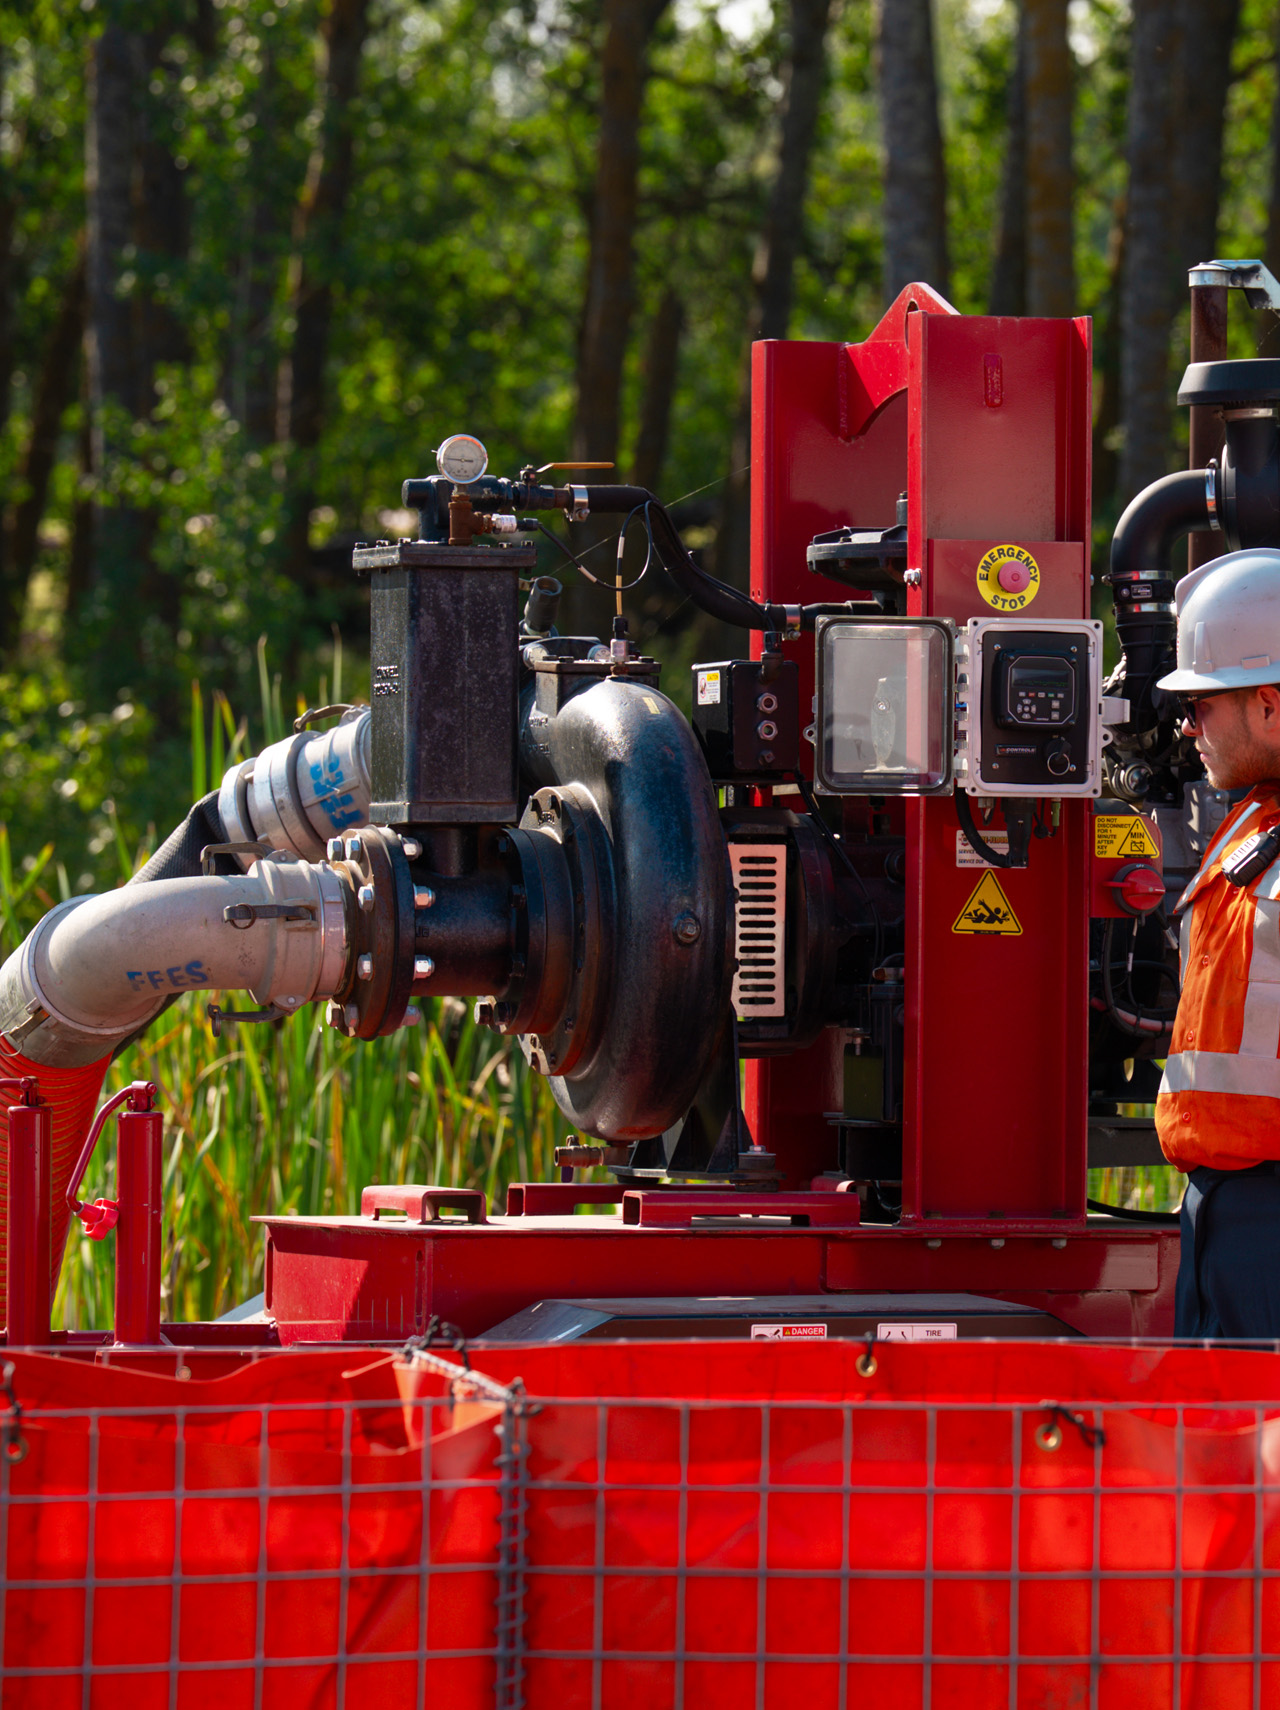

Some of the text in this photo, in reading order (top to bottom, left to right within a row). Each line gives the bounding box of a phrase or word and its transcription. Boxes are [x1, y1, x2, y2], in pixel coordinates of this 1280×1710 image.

[979, 547, 1038, 583] EMERGENCY
[991, 594, 1026, 609] STOP
[126, 960, 208, 991] FFES
[791, 1327, 824, 1335] DANGER
[925, 1329, 942, 1337] TIRE
